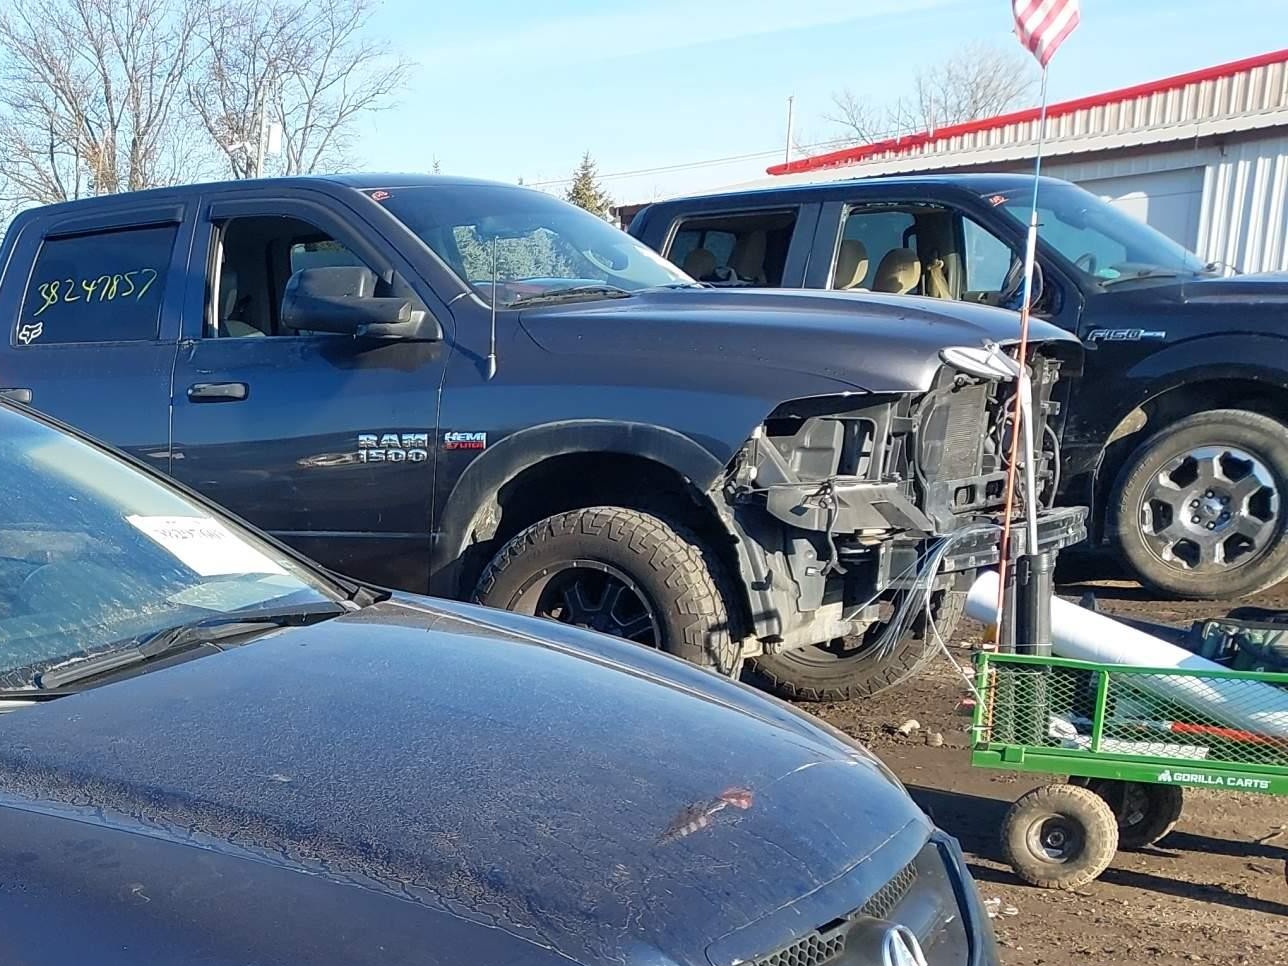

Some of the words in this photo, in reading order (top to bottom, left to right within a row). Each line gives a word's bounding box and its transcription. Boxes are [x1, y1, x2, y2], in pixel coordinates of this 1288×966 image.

[33, 268, 158, 317] 38247857
[358, 433, 428, 448] RAM
[444, 431, 487, 443] HEMI
[358, 449, 428, 463] 1500
[1173, 772, 1224, 785] GORILLA
[1226, 777, 1269, 789] CARTS
